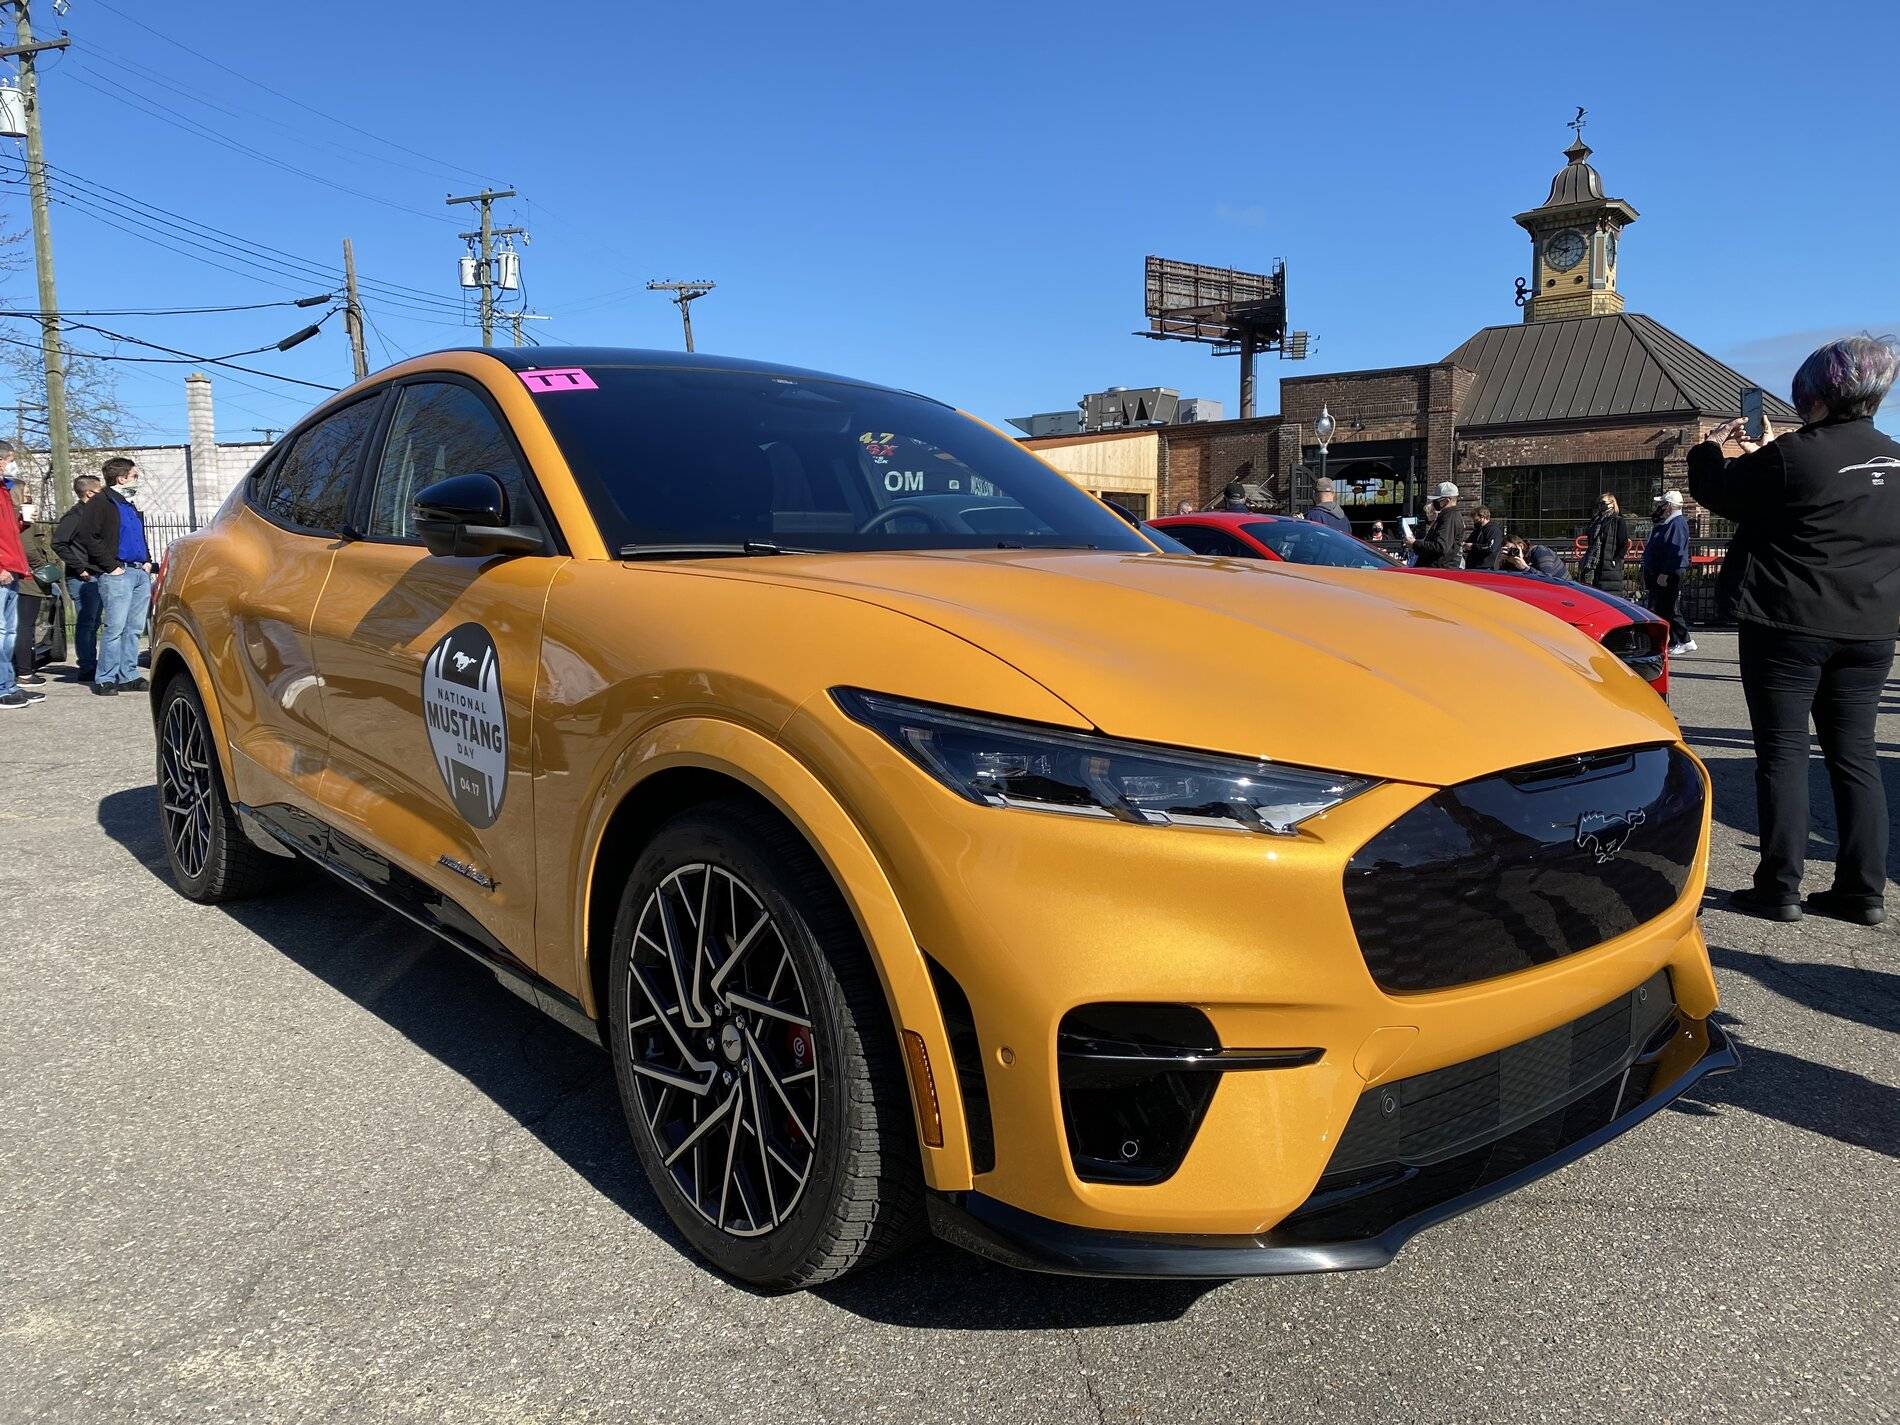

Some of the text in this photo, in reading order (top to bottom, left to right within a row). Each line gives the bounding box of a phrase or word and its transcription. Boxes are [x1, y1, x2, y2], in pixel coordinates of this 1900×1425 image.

[528, 373, 580, 387] TT
[437, 687, 487, 714] NATIONAL
[427, 700, 503, 754] MUSTANG
[457, 742, 475, 760] DAY
[460, 777, 480, 797] 04.17
